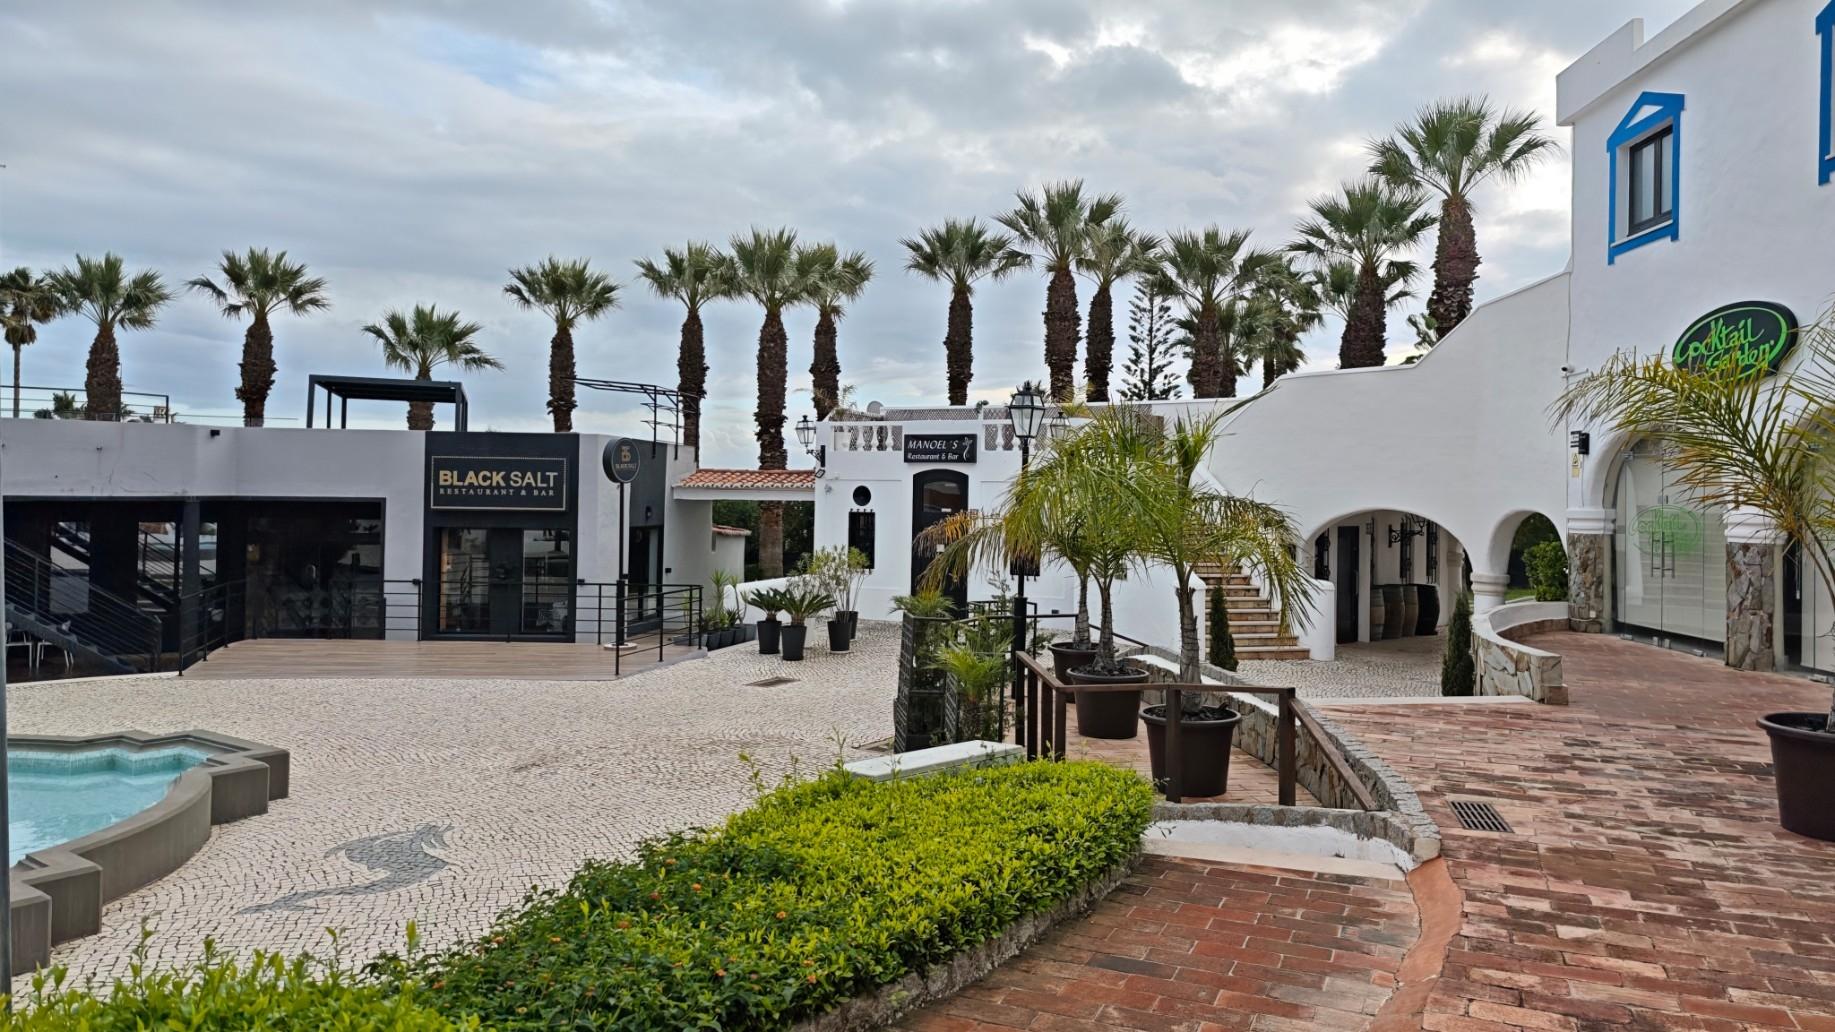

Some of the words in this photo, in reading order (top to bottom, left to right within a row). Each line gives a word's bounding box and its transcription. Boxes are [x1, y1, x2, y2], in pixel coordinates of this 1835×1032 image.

[439, 470, 506, 487] BLACK
[510, 471, 558, 488] SALT
[439, 488, 514, 496] RESTAURANT
[533, 489, 555, 497] BAR
